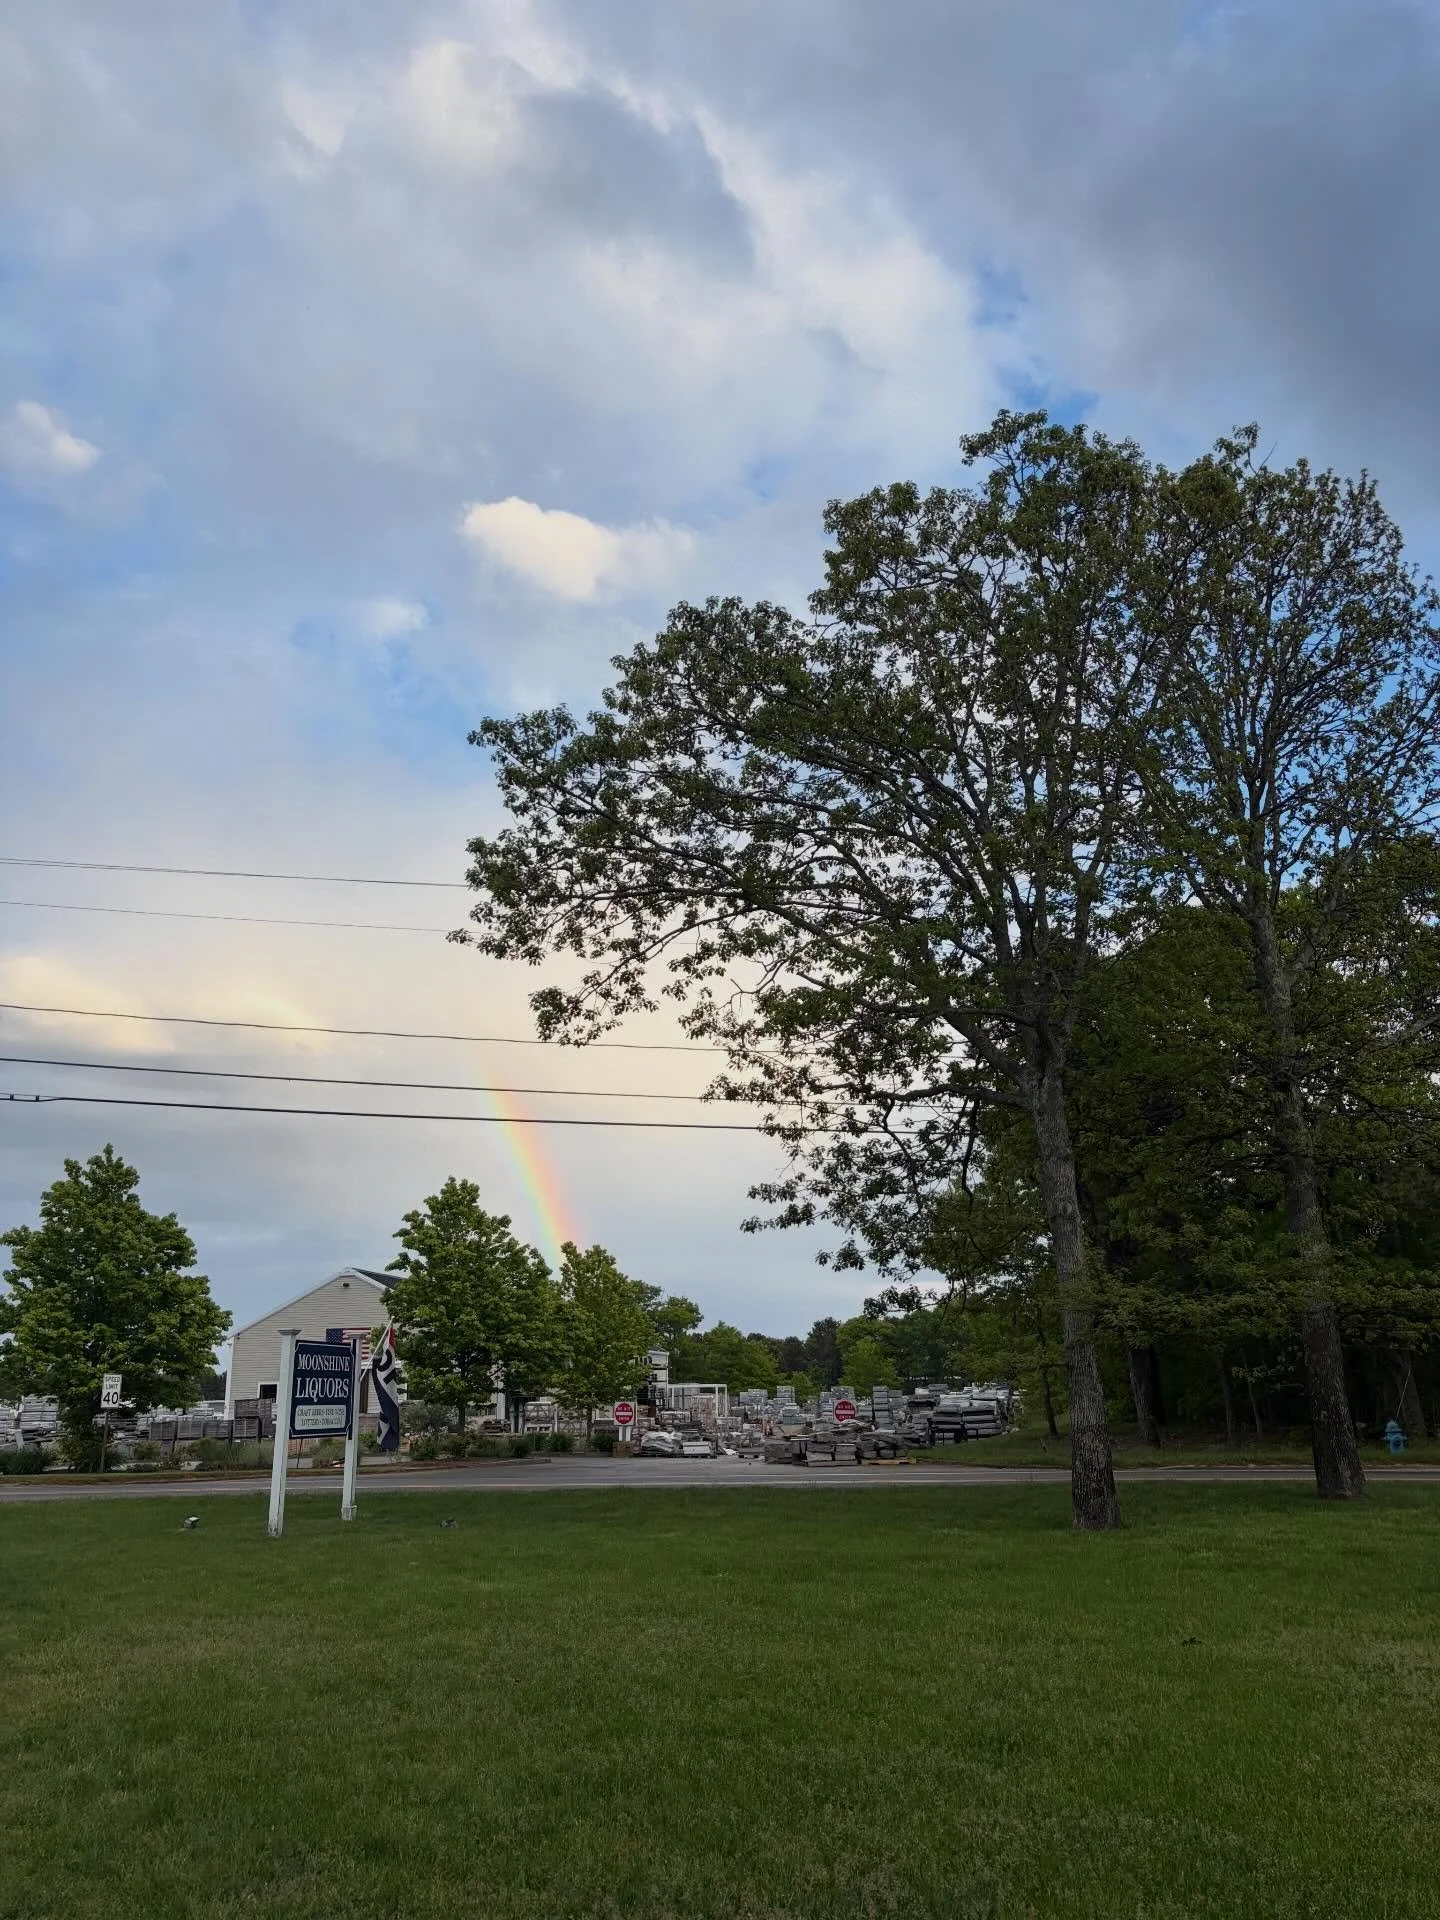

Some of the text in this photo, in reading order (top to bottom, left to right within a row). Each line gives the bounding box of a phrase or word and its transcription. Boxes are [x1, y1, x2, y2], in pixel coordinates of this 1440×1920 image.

[297, 1354, 350, 1371] MOONSHINE
[103, 1391, 119, 1405] 40
[295, 1377, 349, 1402] LIQUORS
